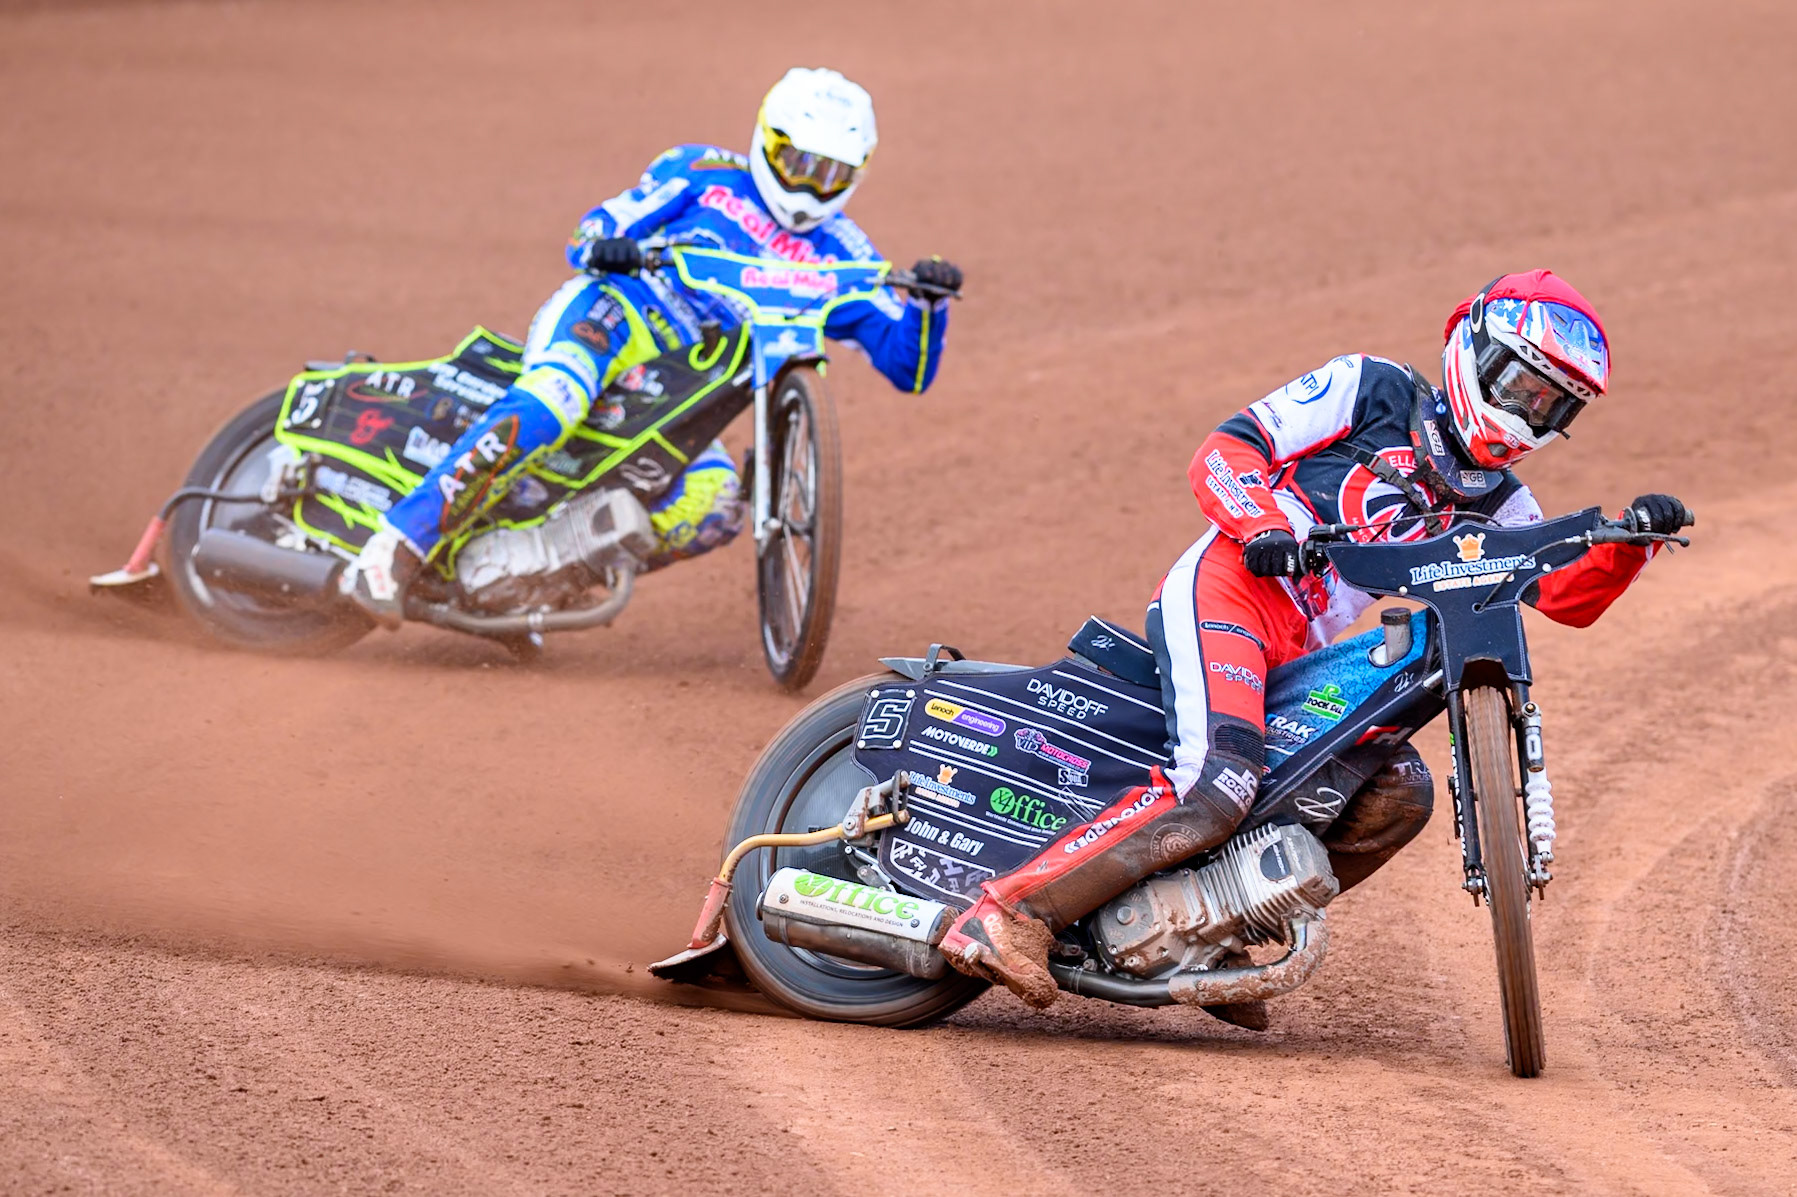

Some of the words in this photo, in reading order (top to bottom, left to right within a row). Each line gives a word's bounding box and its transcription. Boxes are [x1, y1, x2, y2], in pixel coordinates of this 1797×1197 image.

[364, 370, 415, 397] ATR
[439, 432, 507, 503] ATR
[1388, 454, 1418, 469] ELLE
[1027, 678, 1108, 715] DAVIDOFF
[1038, 696, 1086, 719] SPEED
[1307, 697, 1330, 709] ROCK
[862, 698, 910, 740] 5
[961, 713, 1000, 732] engineering
[921, 726, 990, 755] MOTOVERDE
[1041, 744, 1088, 768] MOTOCROSS
[1218, 772, 1248, 800] ROCK
[904, 817, 936, 841] John
[938, 832, 949, 846] &
[950, 832, 985, 857] Gary
